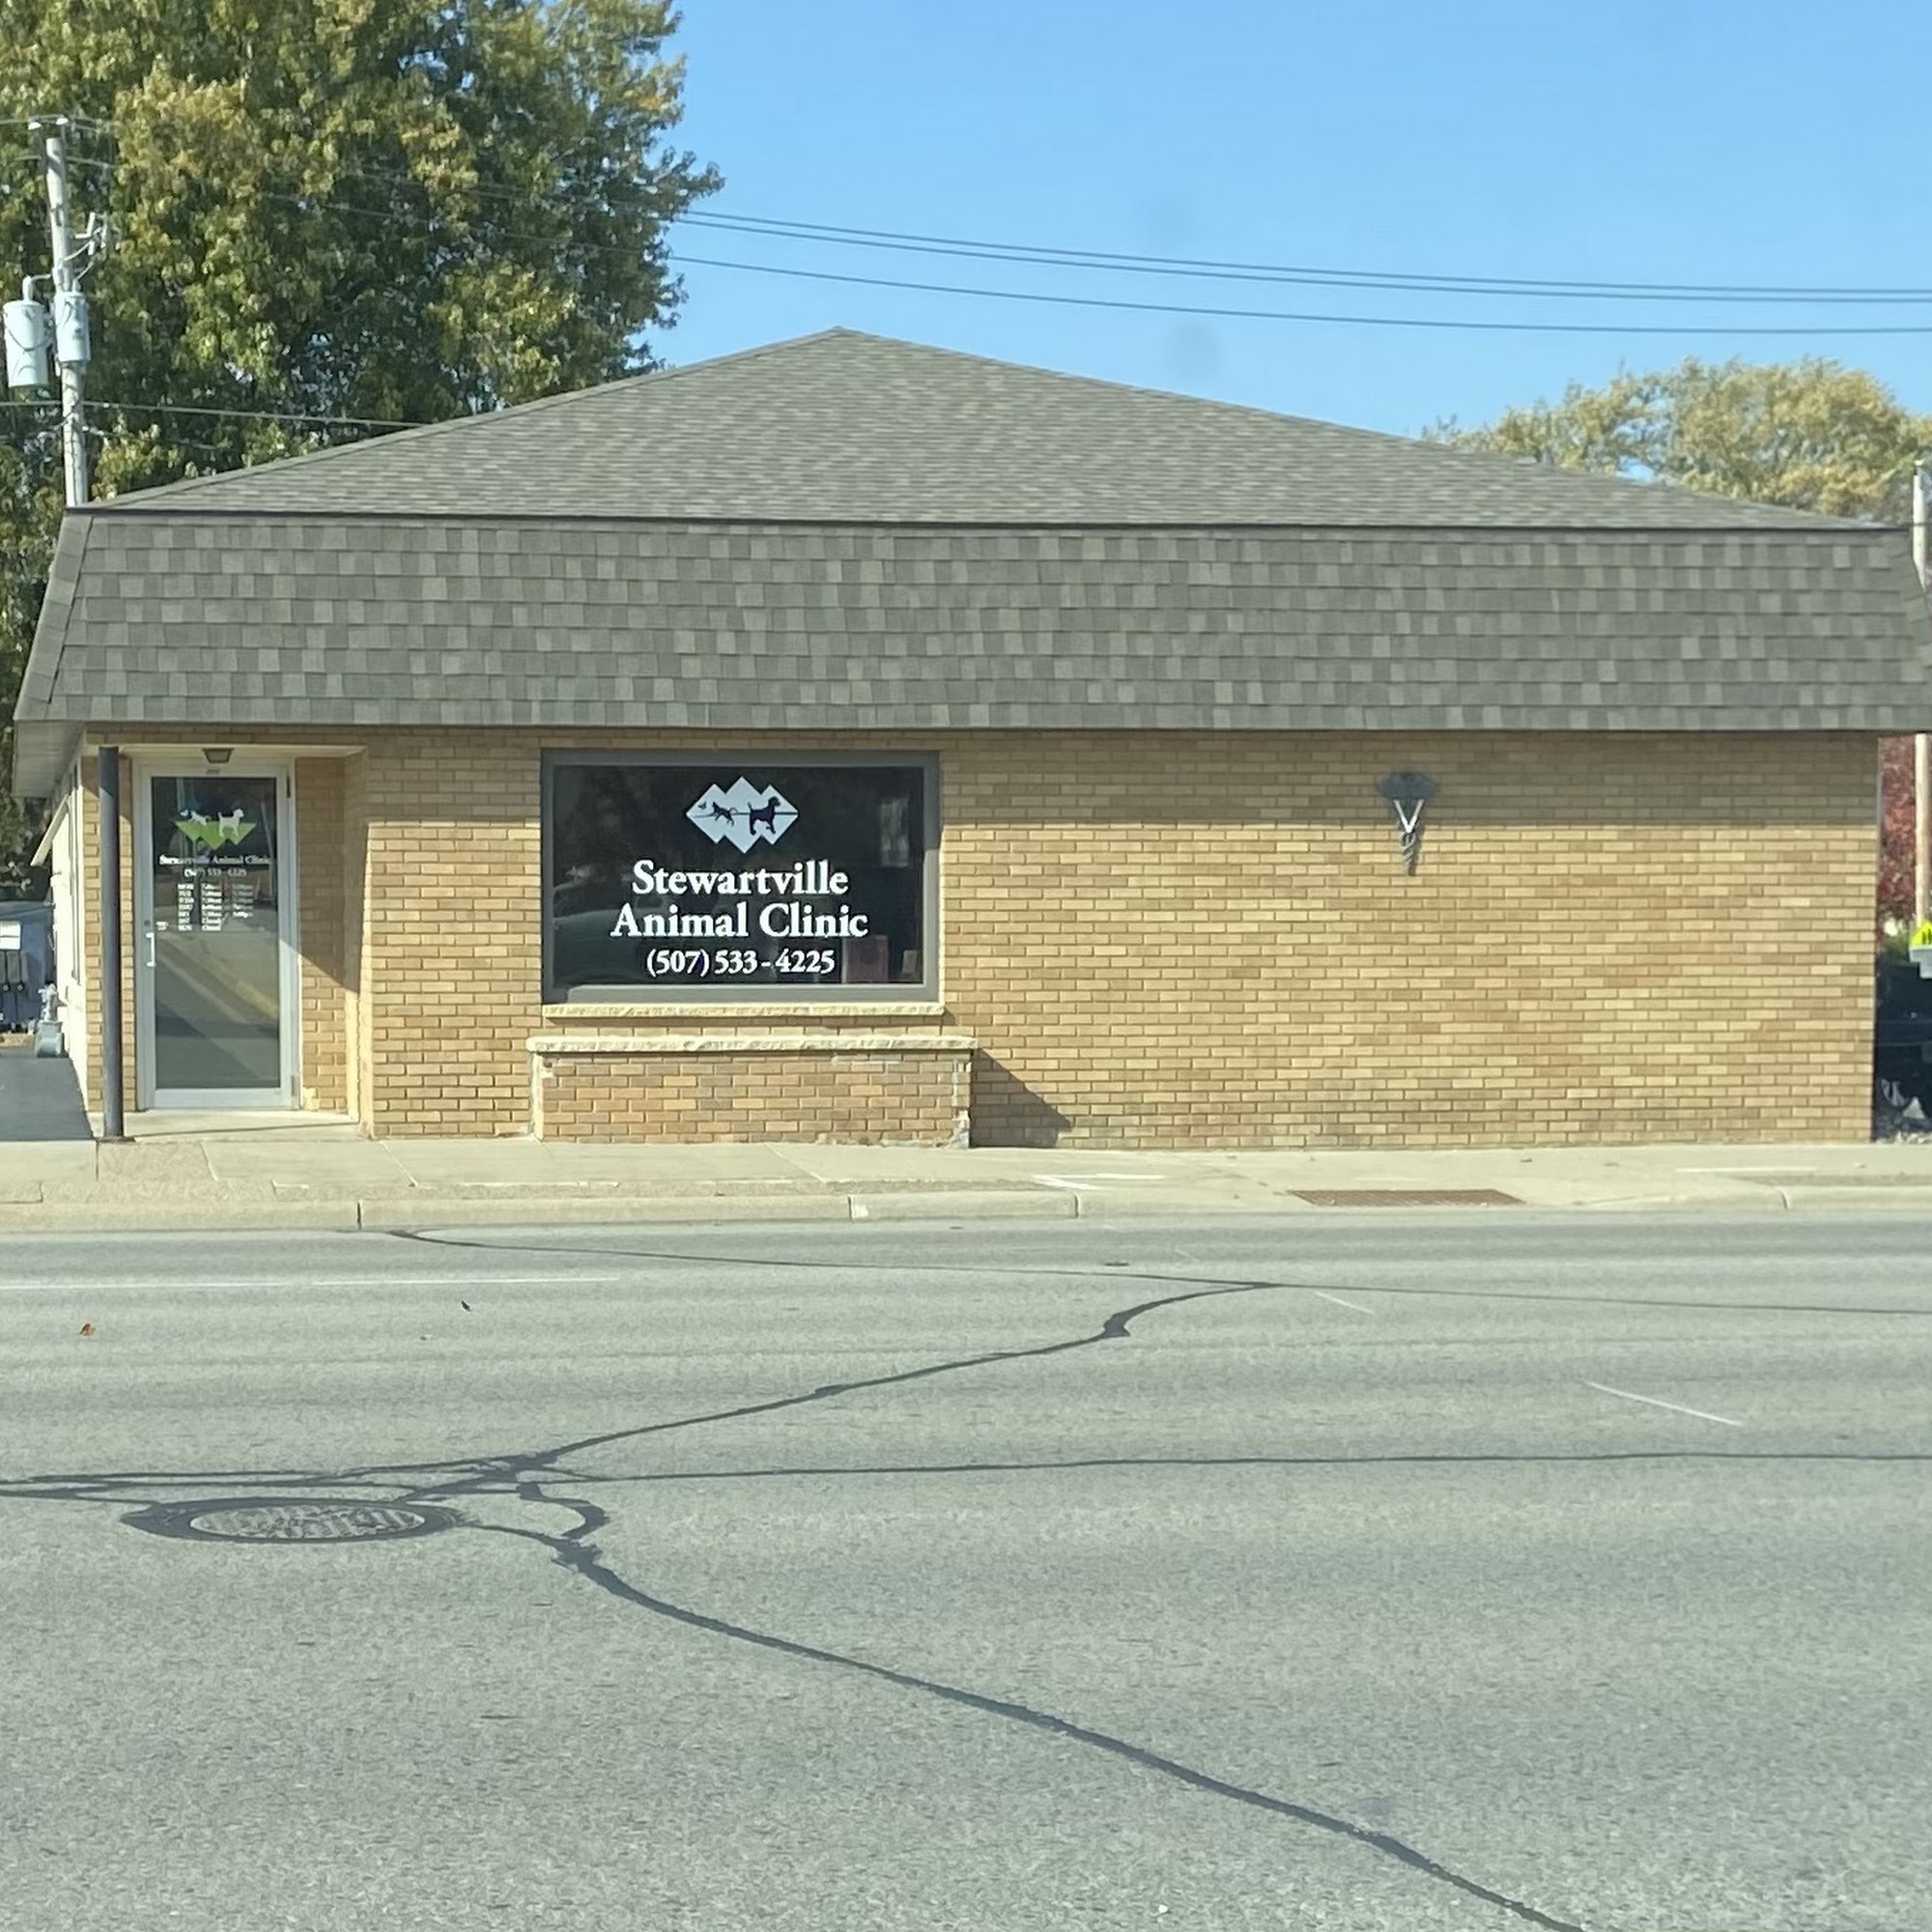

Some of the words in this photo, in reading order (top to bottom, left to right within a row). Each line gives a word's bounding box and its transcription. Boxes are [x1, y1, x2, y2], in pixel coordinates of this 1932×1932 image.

[633, 859, 849, 895] Stewartville
[610, 901, 750, 939] Animal
[759, 901, 868, 939] Clinic
[646, 949, 710, 977] (507)
